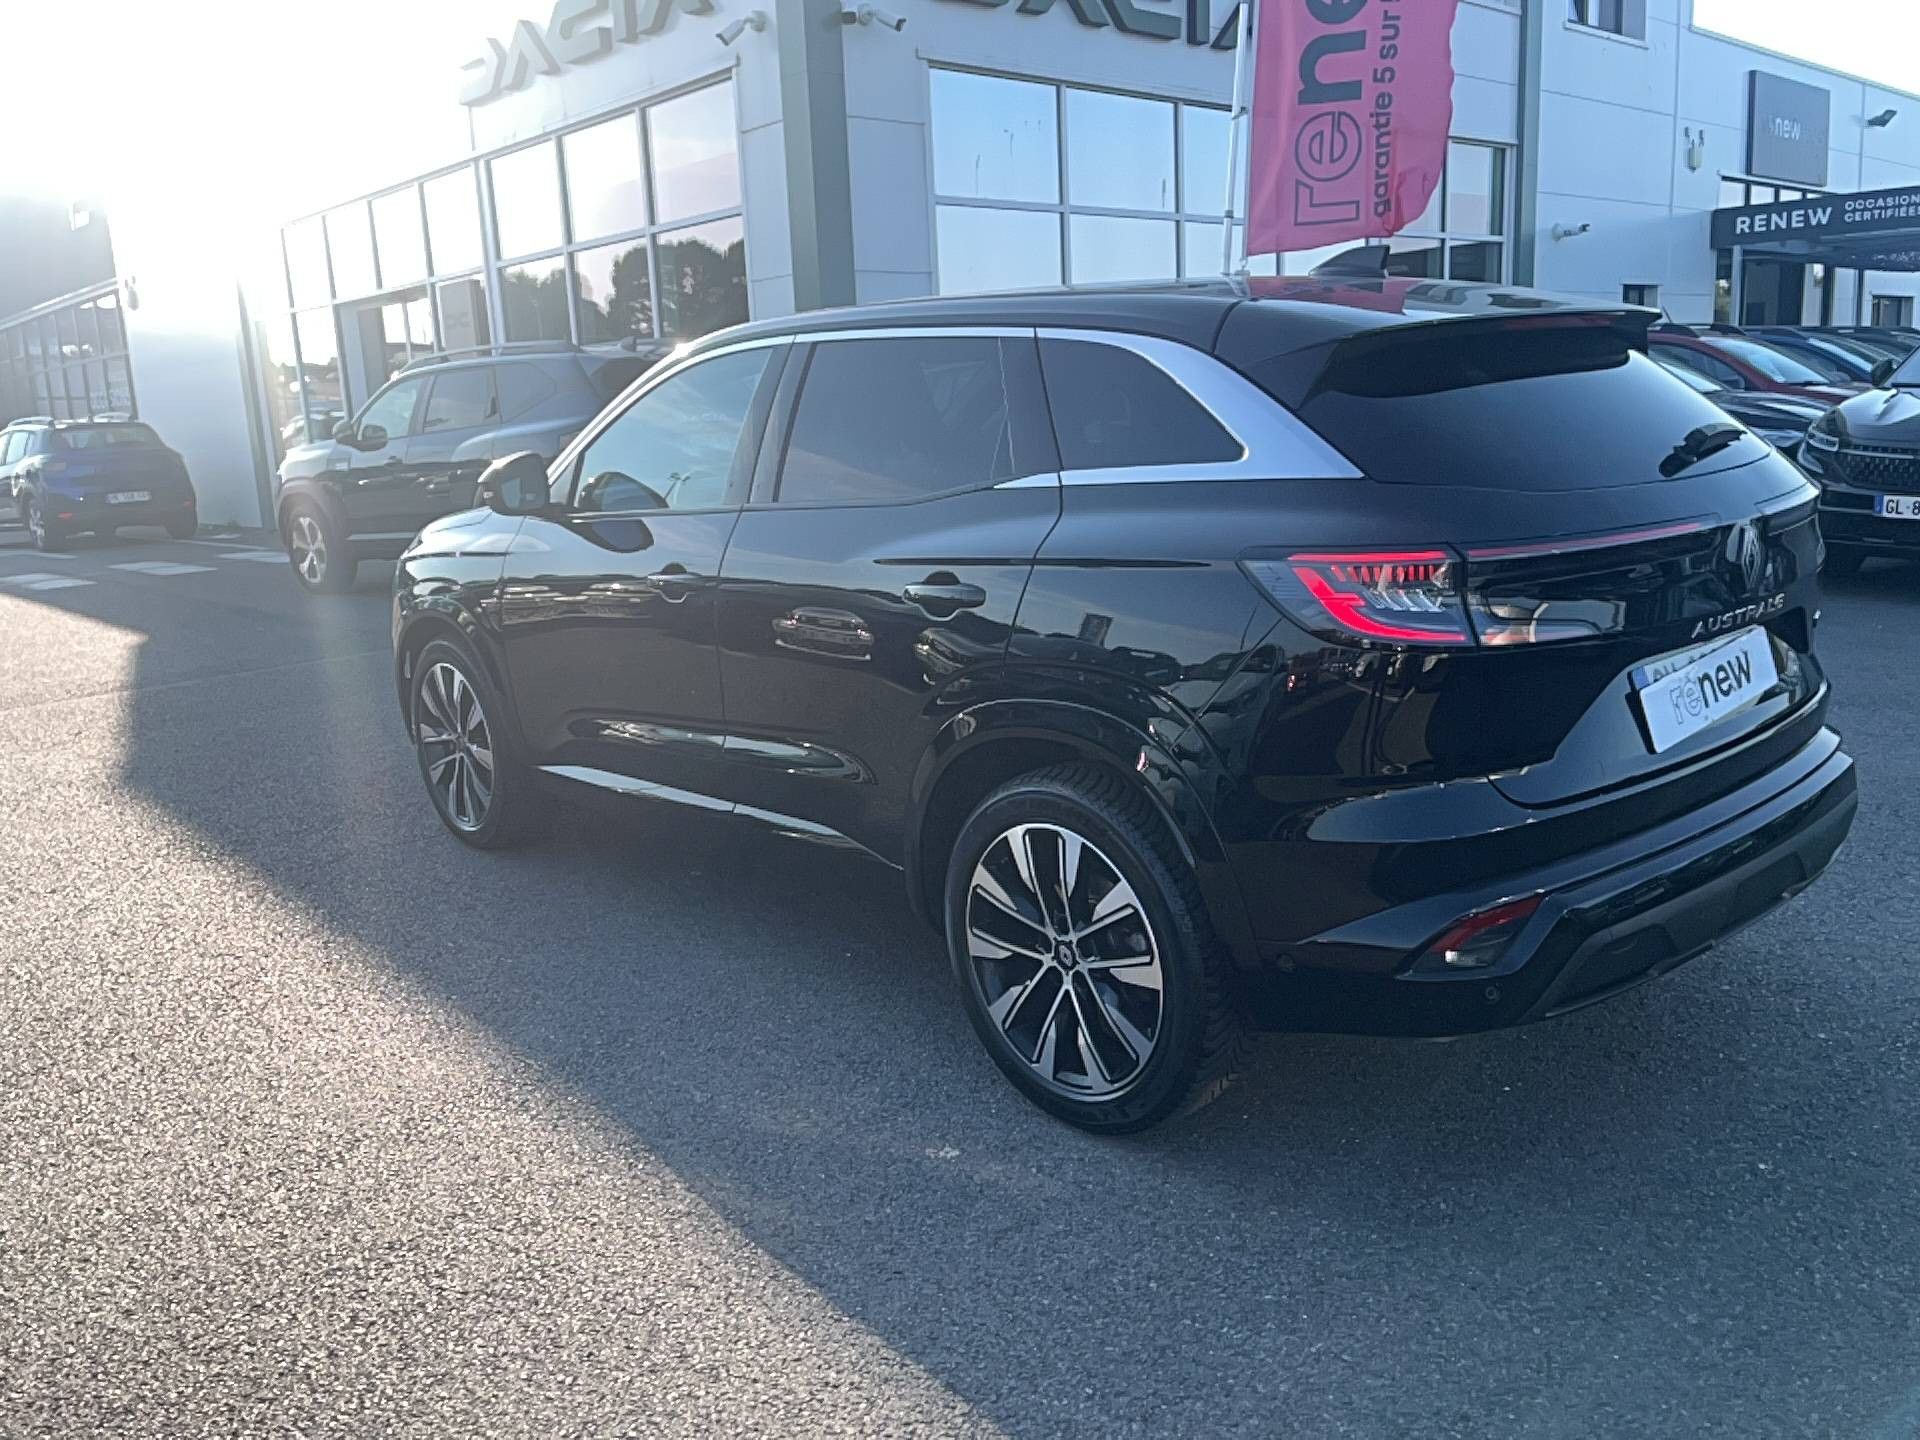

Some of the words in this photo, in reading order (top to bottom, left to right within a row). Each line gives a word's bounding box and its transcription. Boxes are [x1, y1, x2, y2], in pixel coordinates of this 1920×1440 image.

[1379, 9, 1402, 60] sur
[1373, 66, 1396, 84] 5
[1370, 91, 1394, 218] garantie
[1735, 207, 1833, 235] RENEW
[1669, 648, 1752, 726] renew
